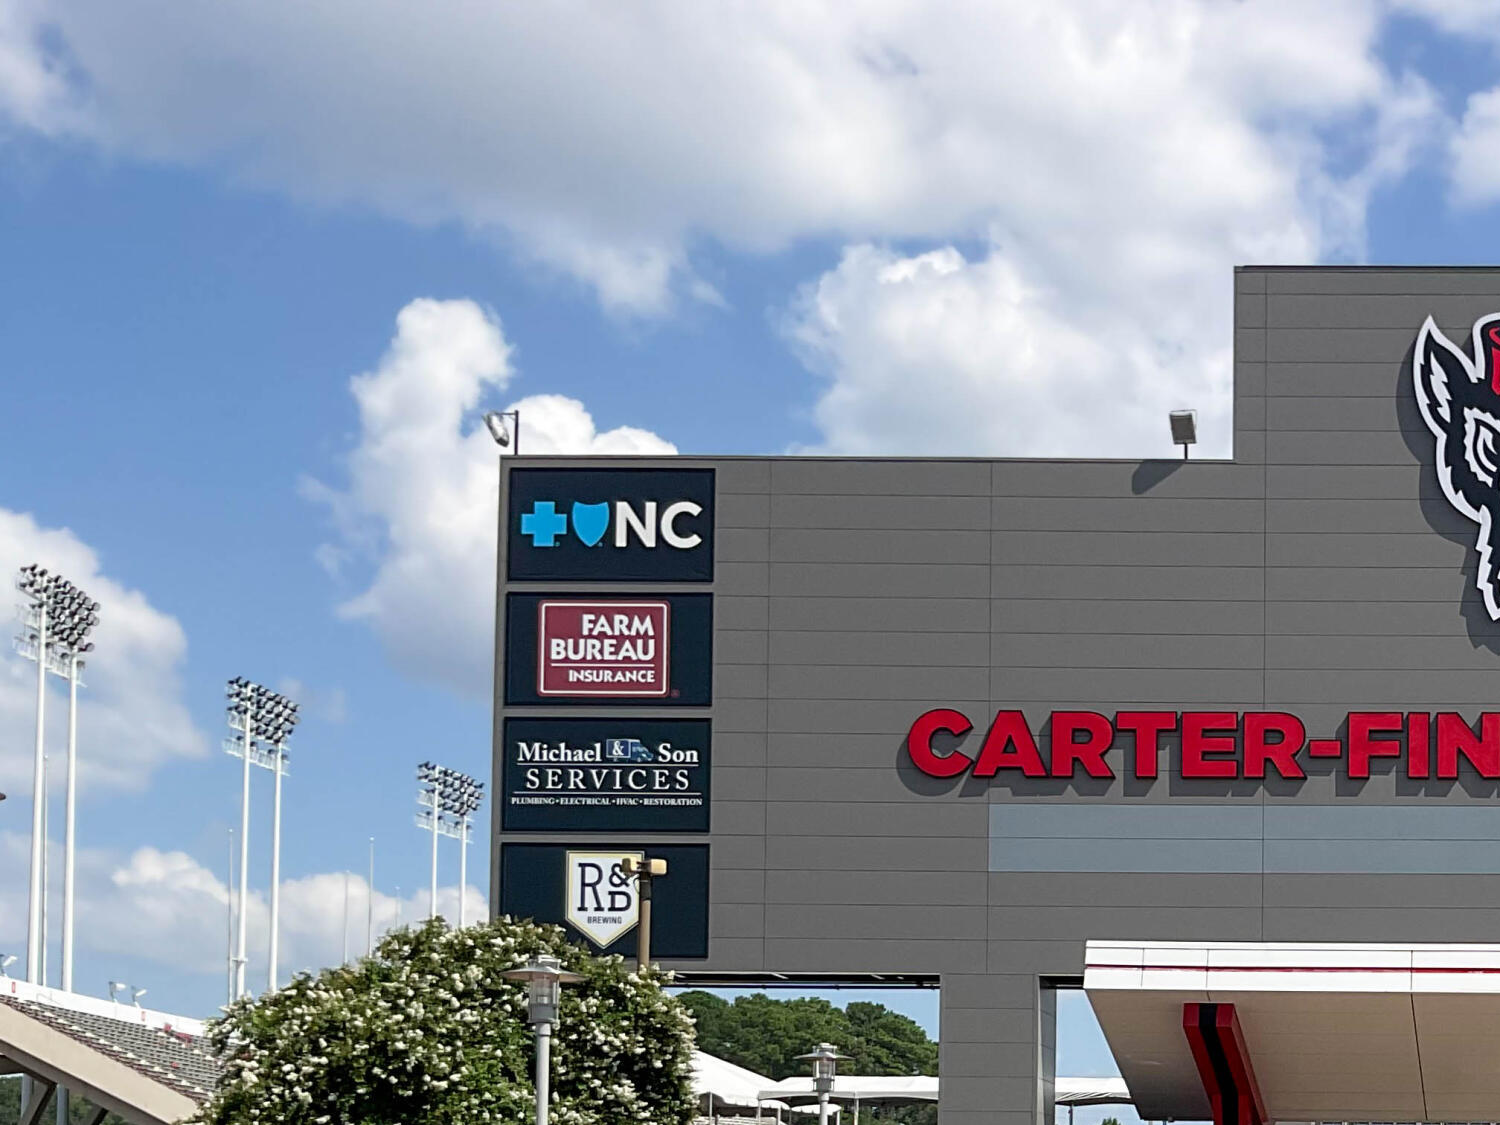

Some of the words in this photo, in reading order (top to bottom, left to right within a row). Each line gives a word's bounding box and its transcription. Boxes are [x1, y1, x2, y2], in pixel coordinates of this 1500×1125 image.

[615, 501, 703, 548] NC
[582, 614, 655, 636] FARM
[550, 638, 655, 661] BUREAU
[568, 669, 655, 683] INSURANCE
[517, 742, 603, 762] Michael
[658, 743, 699, 762] Son
[525, 768, 690, 790] SERVICES
[587, 915, 622, 925] BREWING
